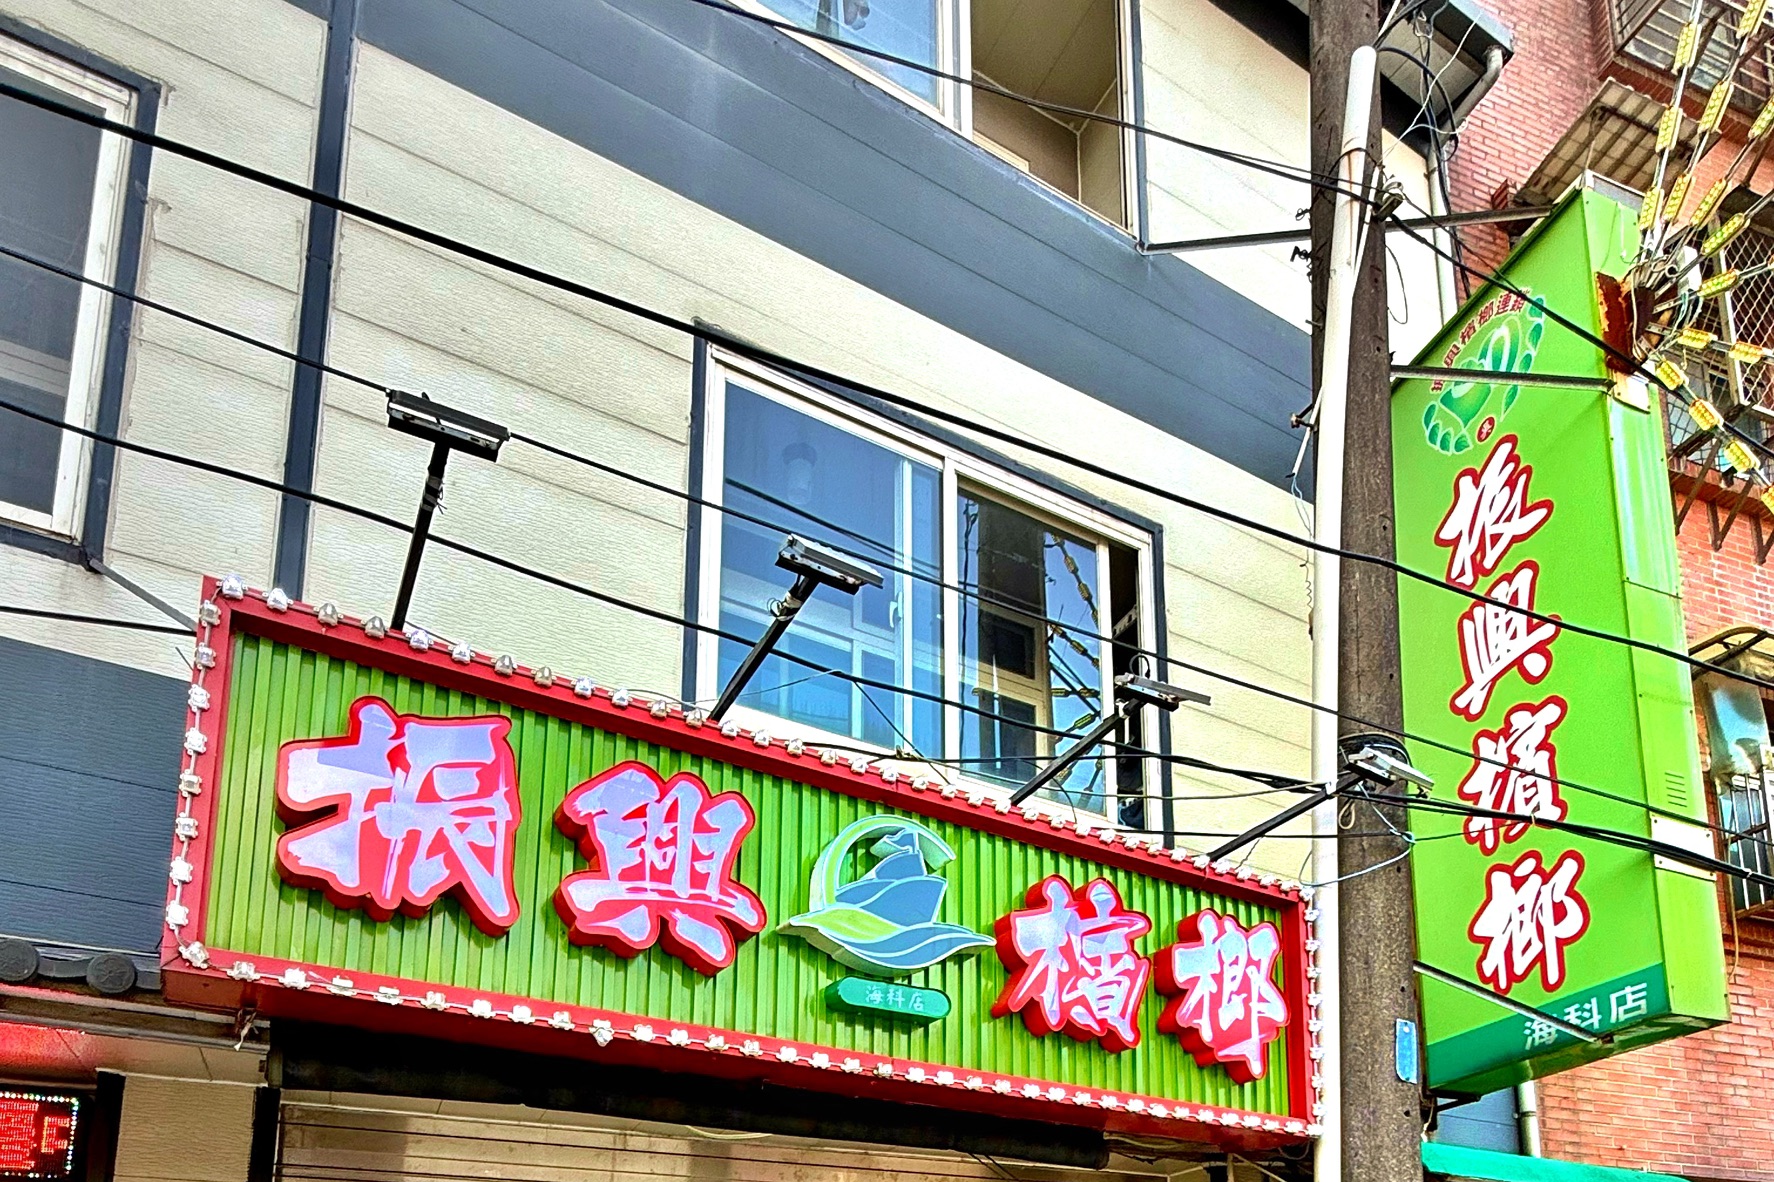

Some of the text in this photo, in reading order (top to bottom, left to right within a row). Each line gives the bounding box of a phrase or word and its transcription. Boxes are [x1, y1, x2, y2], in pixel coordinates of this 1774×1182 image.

[276, 697, 1290, 1081] 振興 檳榔
[1434, 434, 1590, 995] 振興檳榔
[865, 984, 925, 1012] 海科店
